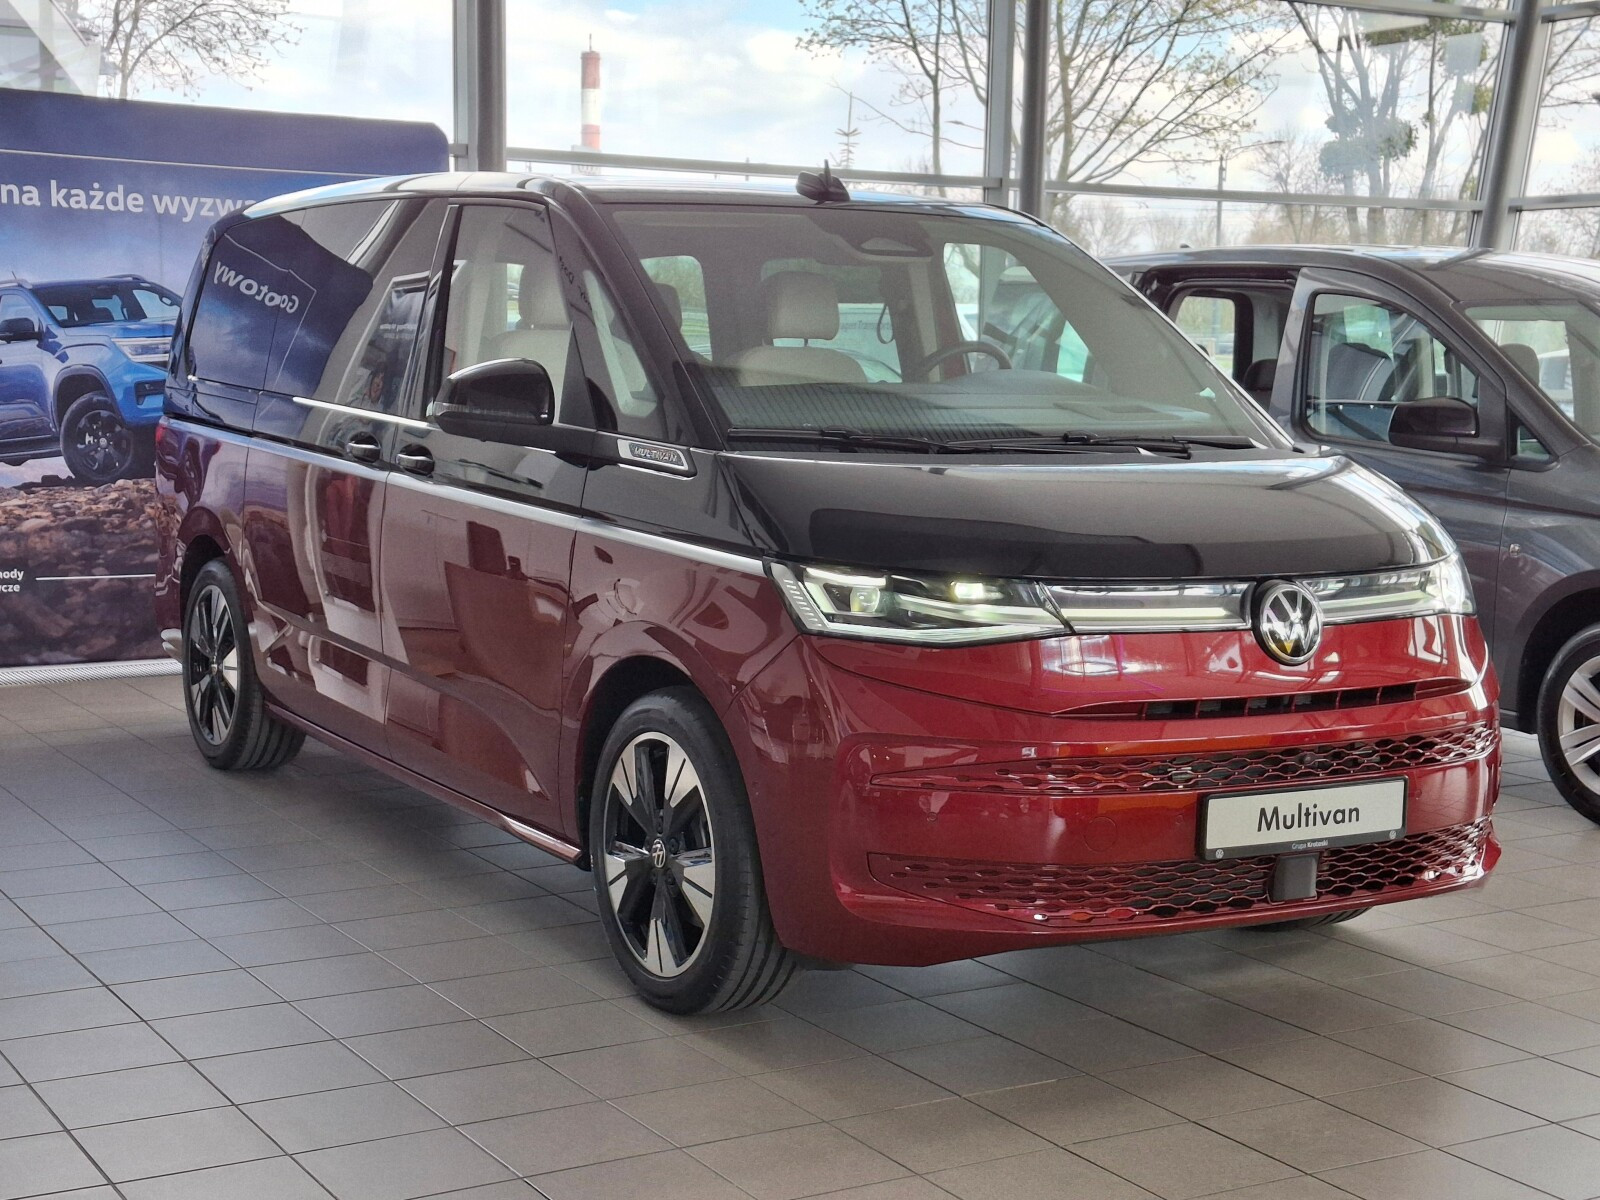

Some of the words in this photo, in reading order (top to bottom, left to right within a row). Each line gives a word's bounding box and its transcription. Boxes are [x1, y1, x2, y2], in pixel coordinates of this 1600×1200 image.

[0, 184, 40, 206] na
[50, 179, 144, 213] każde
[152, 194, 256, 223] wyzw
[634, 446, 677, 462] MULTIVAN
[0, 584, 20, 592] cze
[1257, 802, 1360, 832] Multivan
